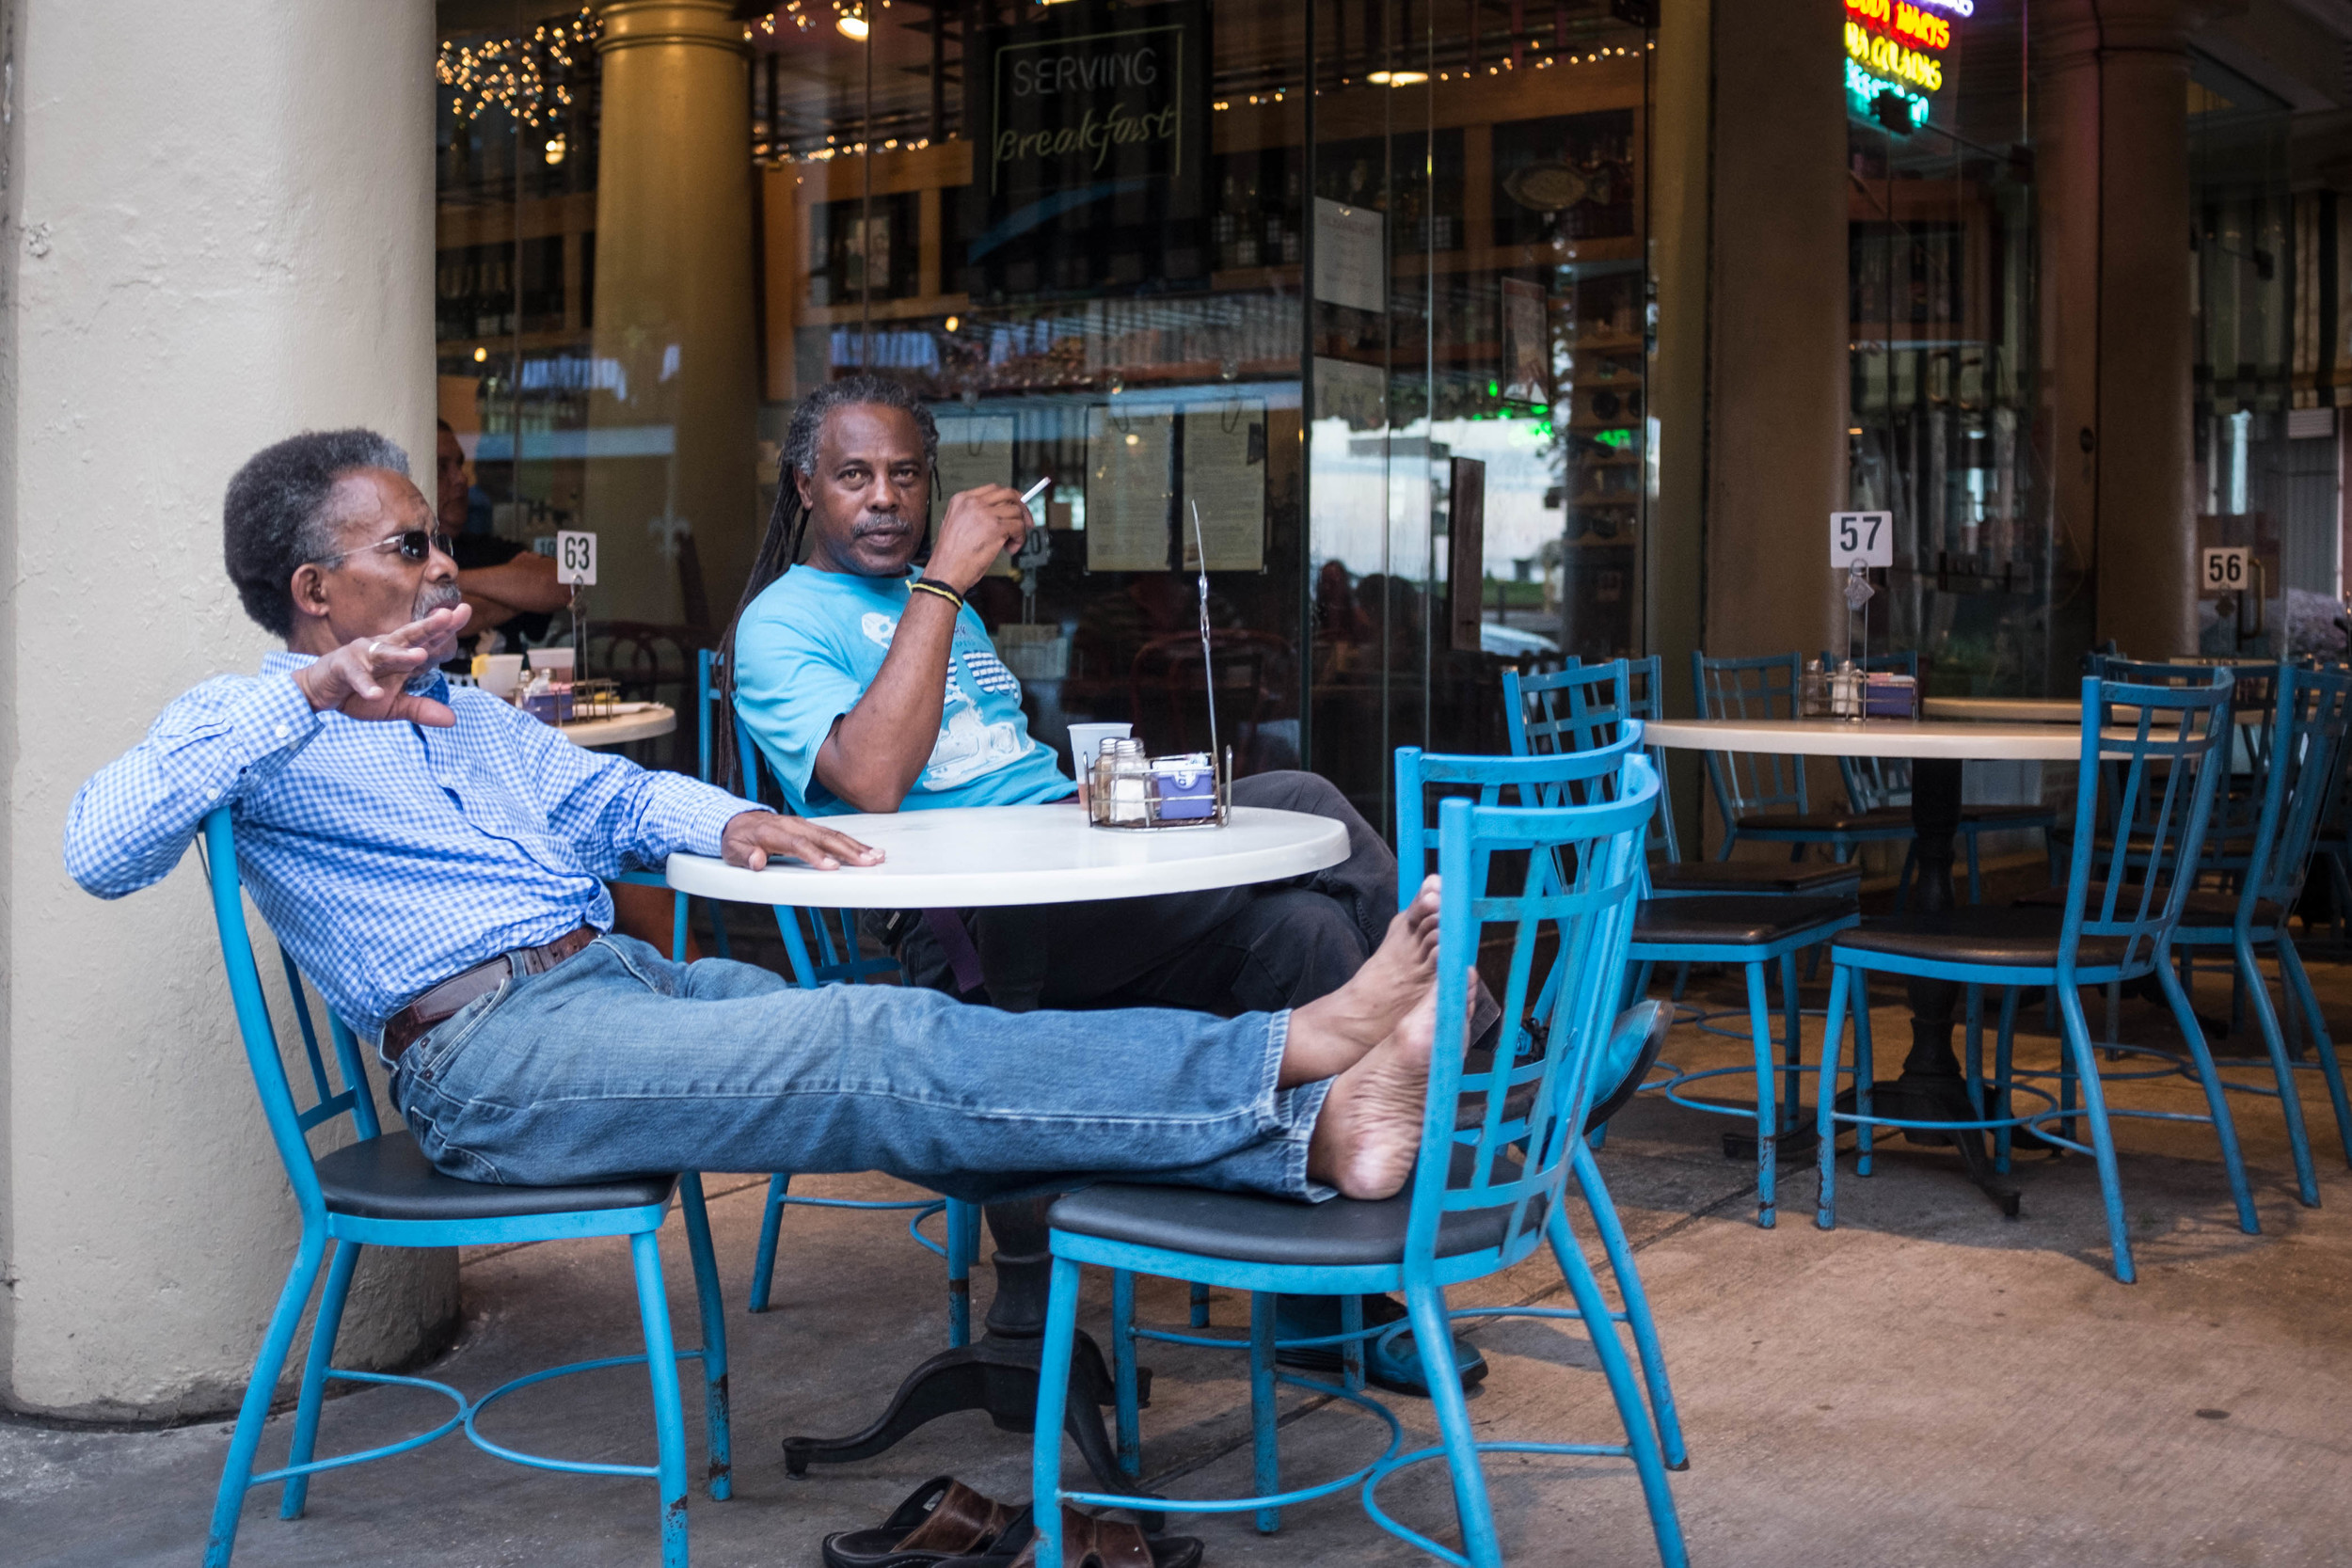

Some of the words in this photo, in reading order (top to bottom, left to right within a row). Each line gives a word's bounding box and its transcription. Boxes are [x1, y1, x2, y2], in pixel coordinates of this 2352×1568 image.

[1012, 47, 1157, 96] SERVING
[1839, 515, 1883, 552] 57
[564, 536, 590, 570] 63
[2209, 553, 2242, 583] 56
